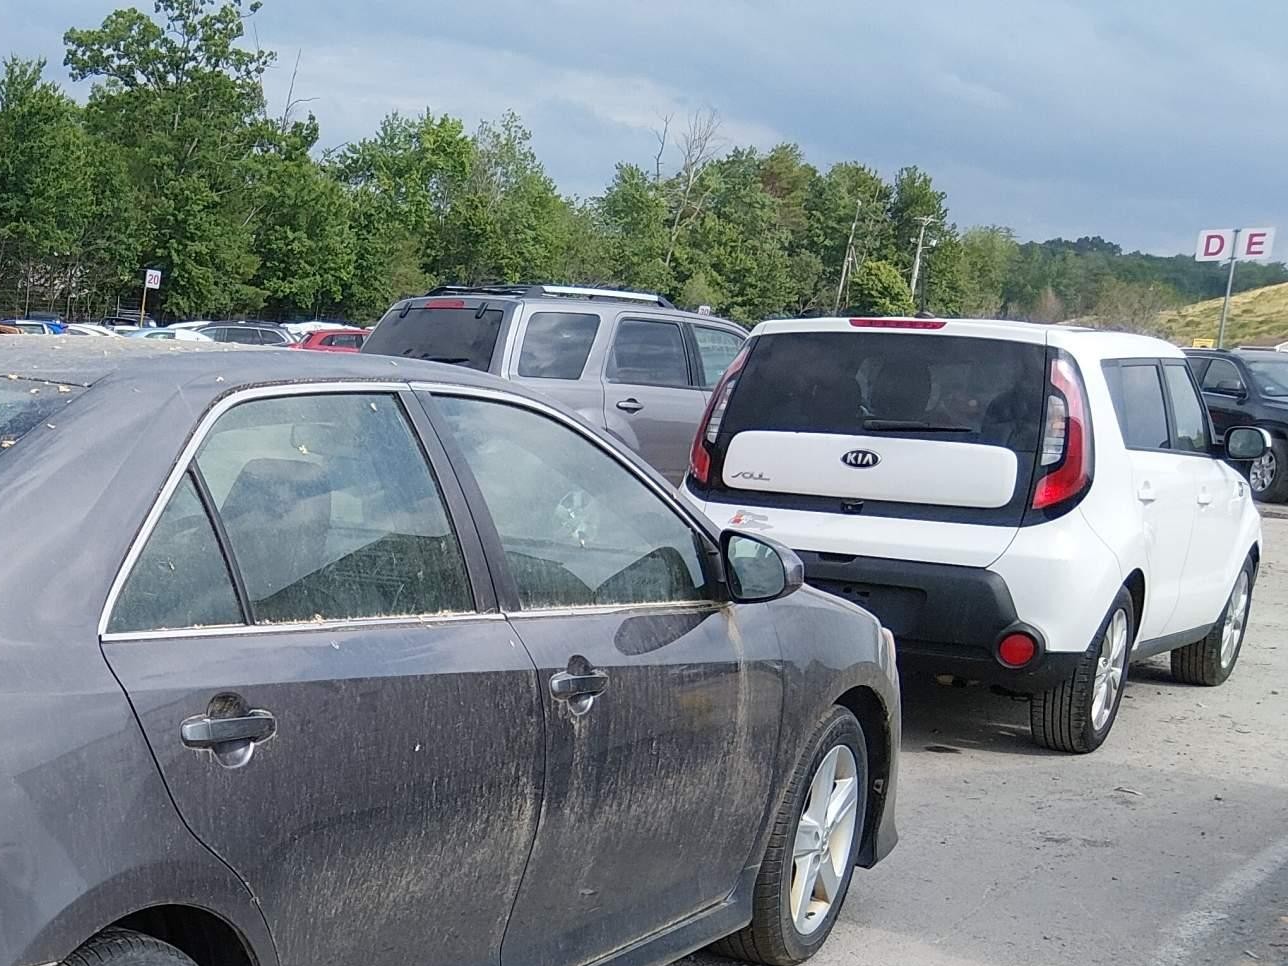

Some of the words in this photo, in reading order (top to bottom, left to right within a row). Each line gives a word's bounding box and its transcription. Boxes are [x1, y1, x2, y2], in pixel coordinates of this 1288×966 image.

[1203, 234, 1224, 257] D
[1245, 232, 1267, 255] E
[148, 273, 160, 285] 20
[846, 452, 874, 465] KIA
